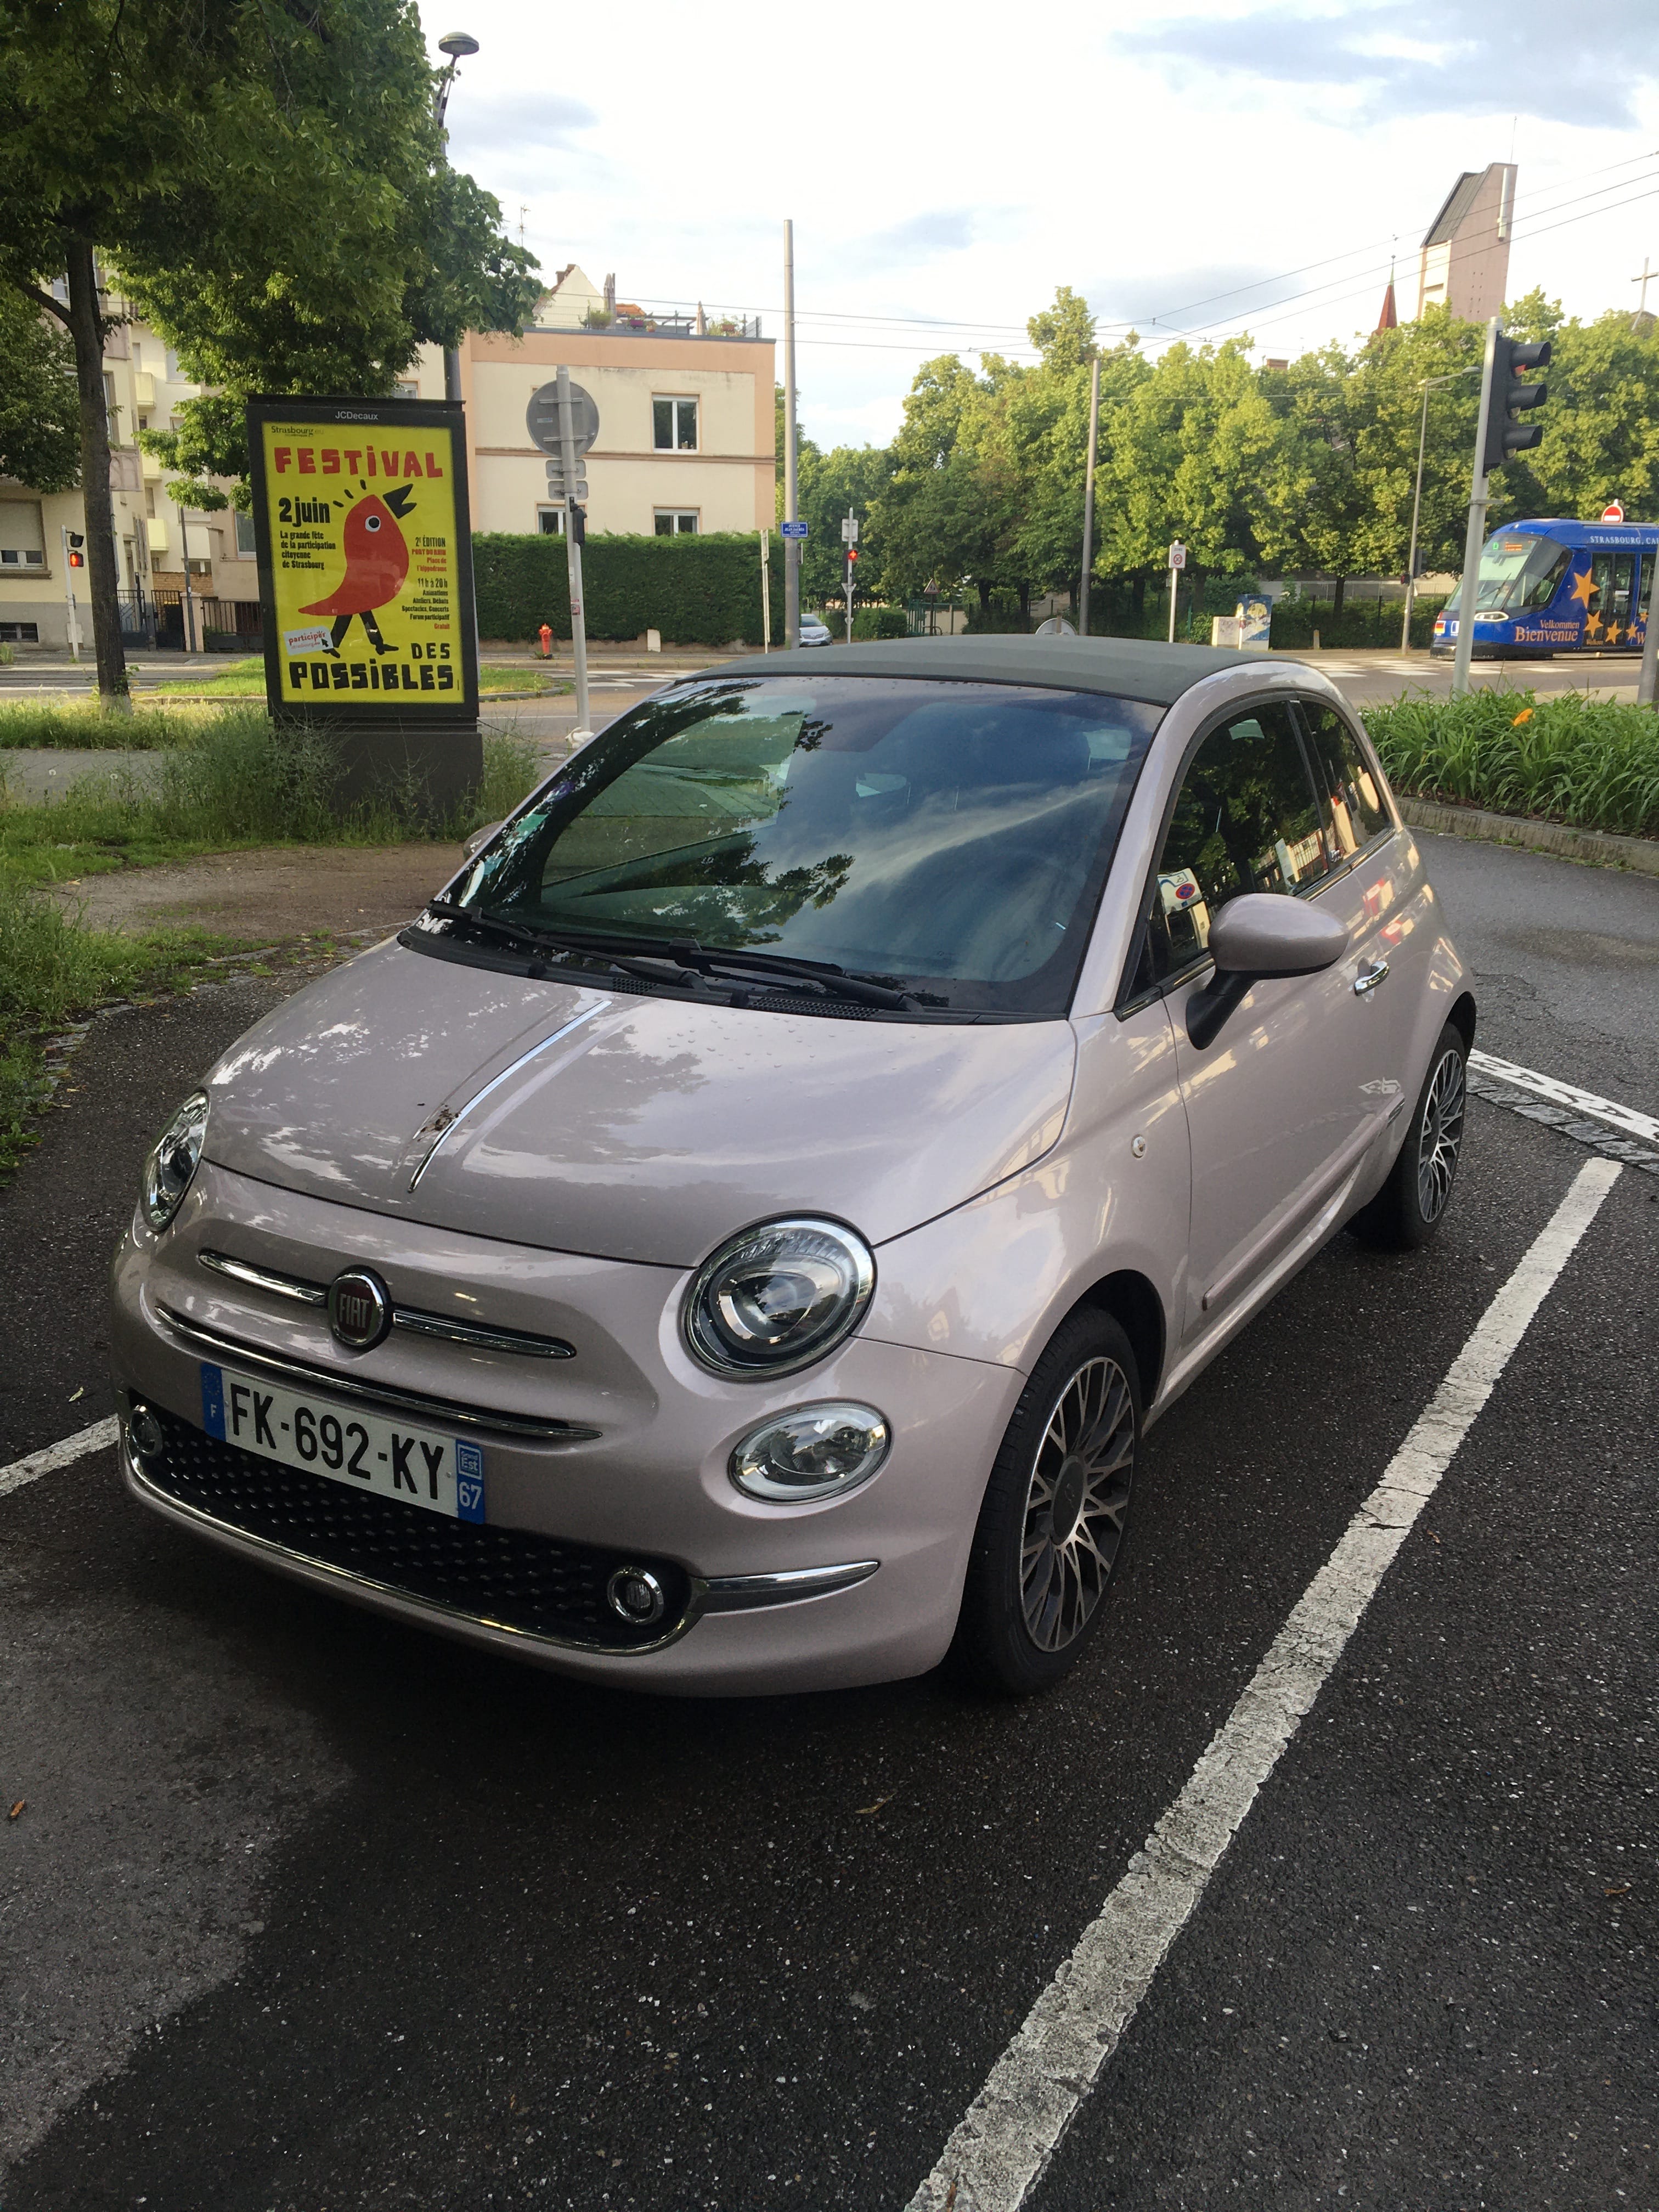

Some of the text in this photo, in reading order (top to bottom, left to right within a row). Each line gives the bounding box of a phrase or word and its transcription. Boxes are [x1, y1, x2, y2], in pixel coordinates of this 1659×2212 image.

[335, 411, 379, 420] JCDecaux
[279, 496, 330, 527] 2 juin
[290, 531, 310, 540] grande
[312, 531, 324, 539] fête
[422, 534, 445, 547] ÉDITION
[290, 540, 296, 549] la
[297, 541, 336, 551] participation
[281, 551, 311, 560] citoyenne
[291, 561, 324, 570] Strasbourg
[436, 578, 443, 588] 20
[1540, 619, 1580, 629] Velkommen
[289, 630, 325, 646] participer
[1514, 625, 1578, 642] Bienvenue
[411, 642, 450, 659] DES
[340, 1293, 370, 1329] FIAT
[211, 1383, 444, 1500] F FK-692-KY
[459, 1481, 482, 1510] 67
